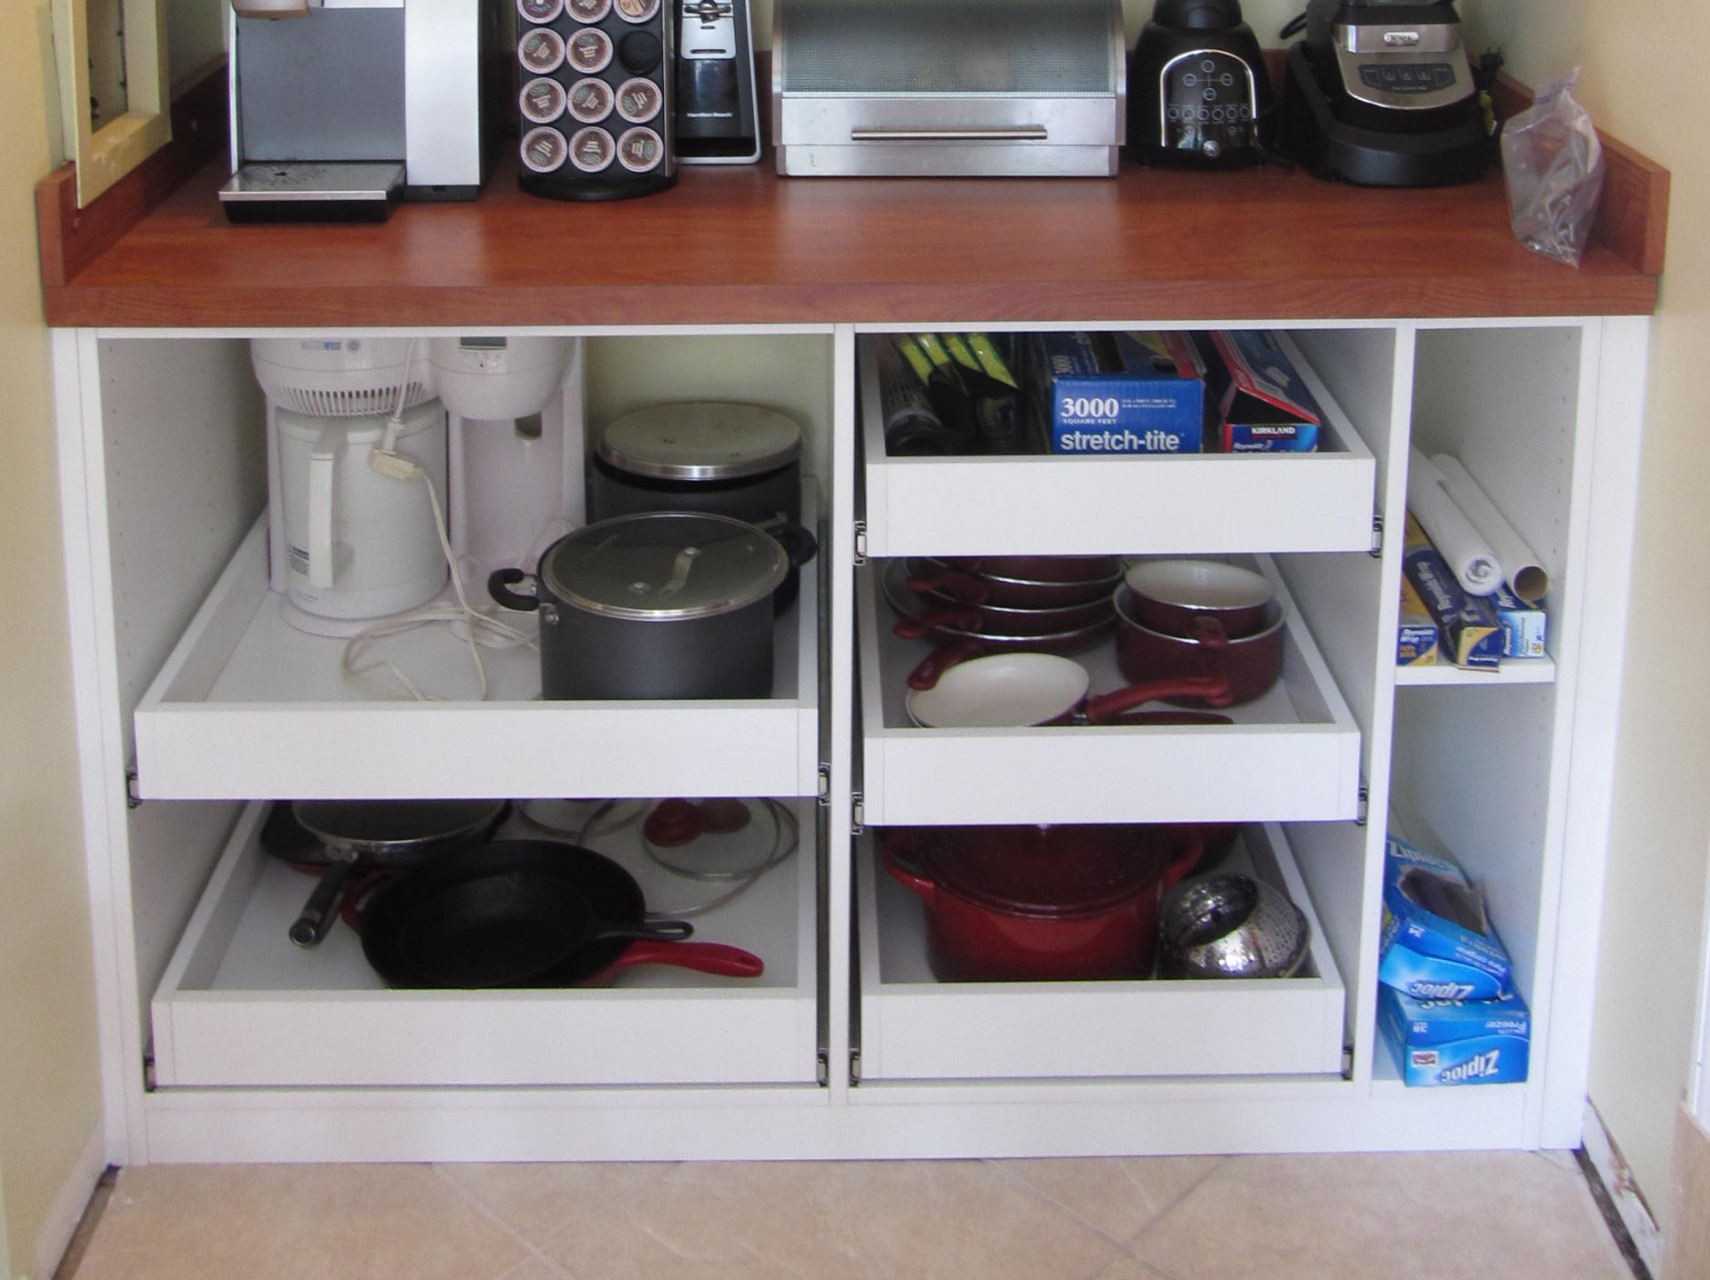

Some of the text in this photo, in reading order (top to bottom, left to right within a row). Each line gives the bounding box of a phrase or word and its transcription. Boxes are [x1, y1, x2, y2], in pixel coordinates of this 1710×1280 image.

[1061, 397, 1119, 418] 3000
[1061, 429, 1180, 451] stretch-tite
[1251, 426, 1296, 435] KIRKLAND
[1410, 981, 1475, 1000] Ziploc
[1440, 1048, 1500, 1083] Ziploc
